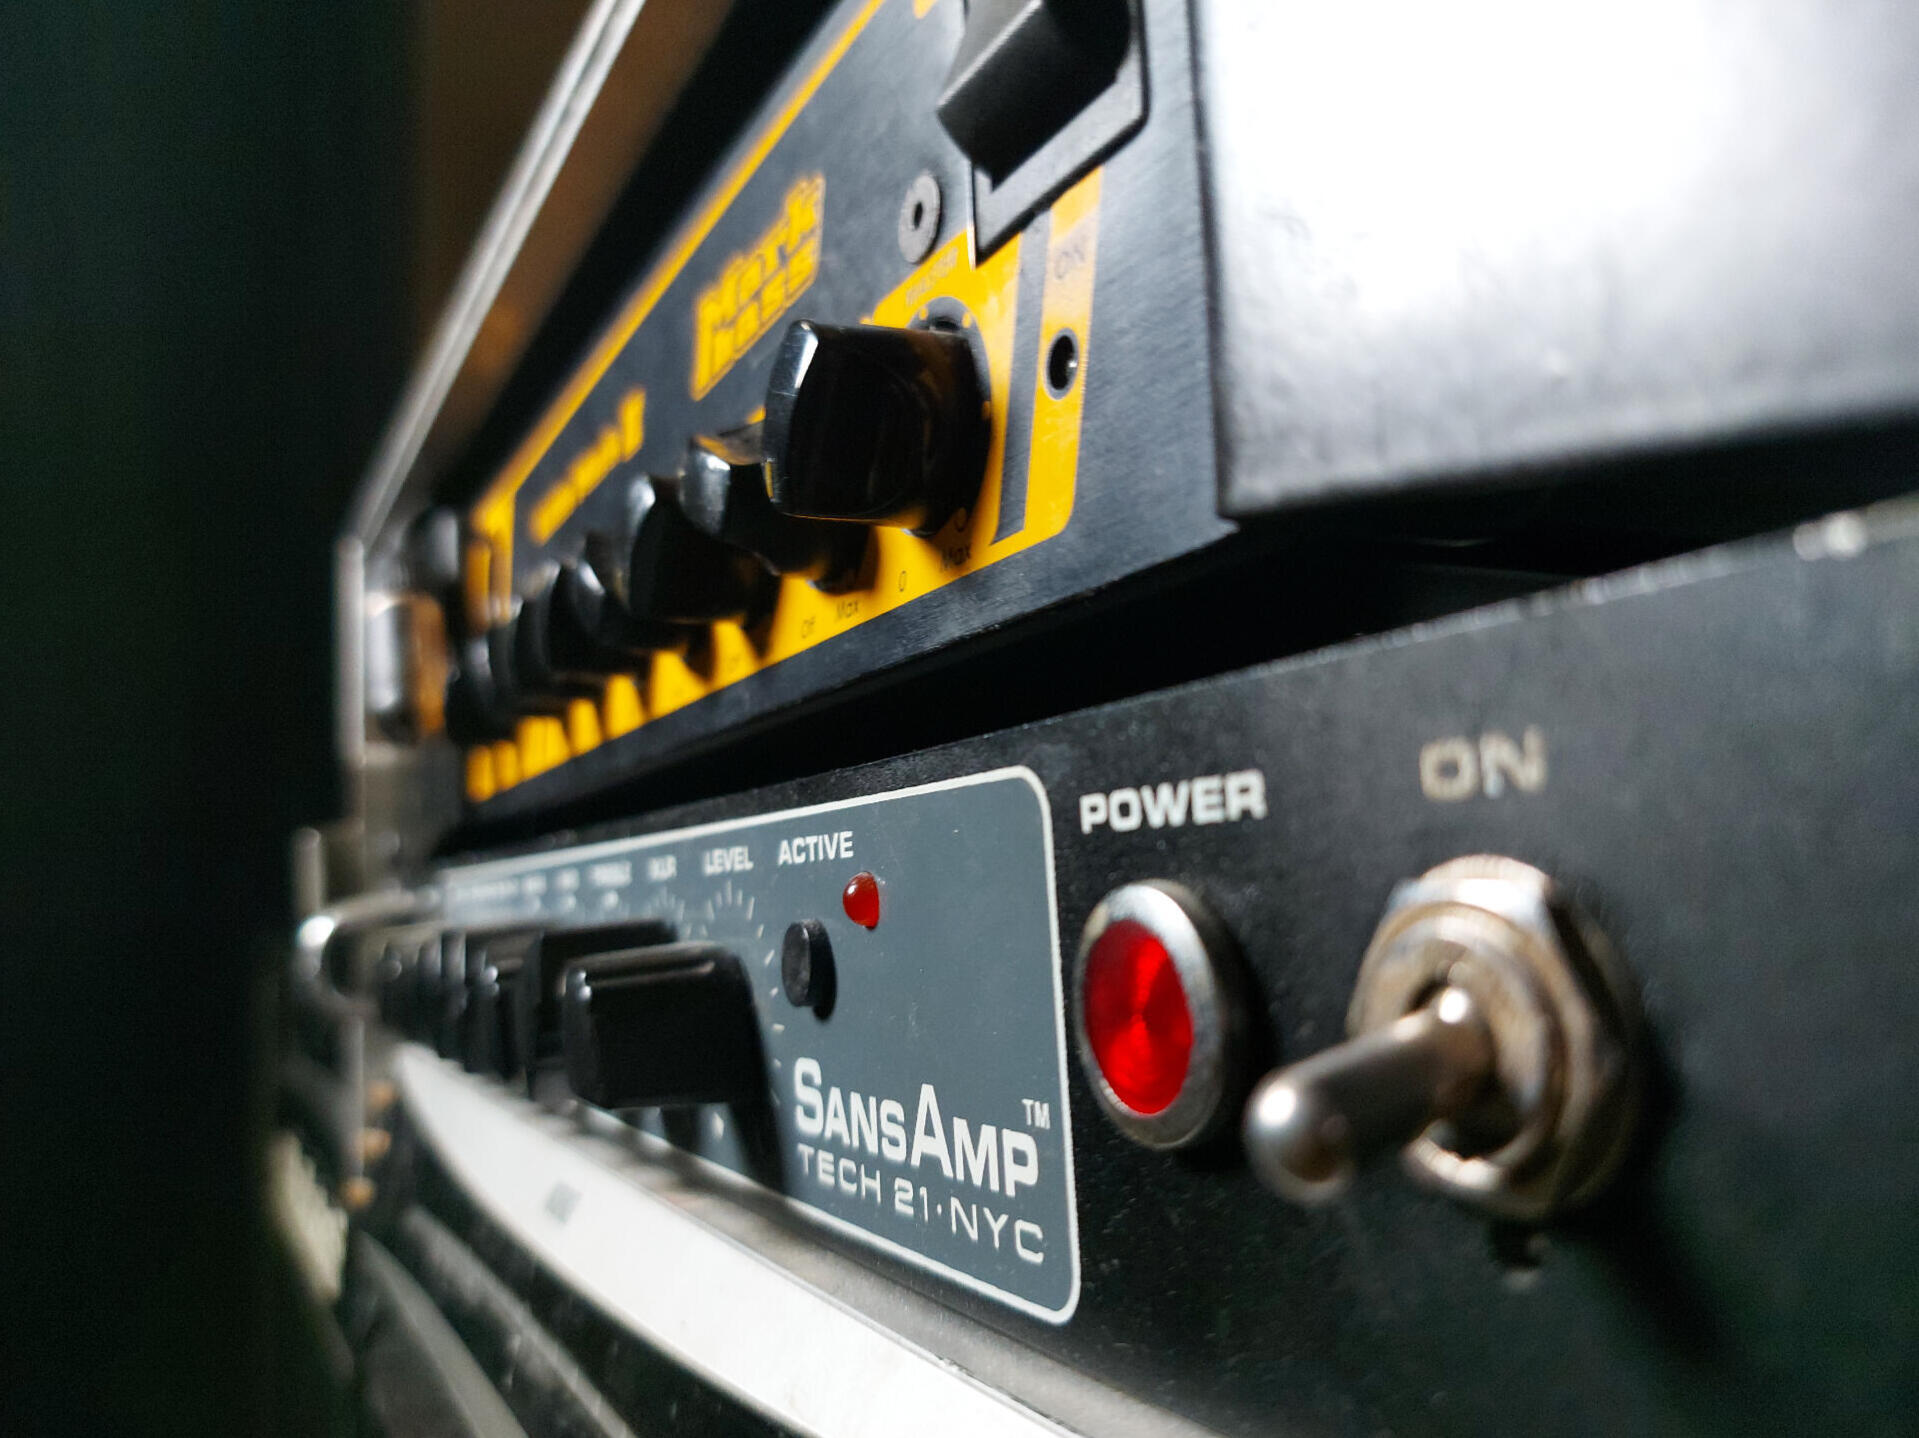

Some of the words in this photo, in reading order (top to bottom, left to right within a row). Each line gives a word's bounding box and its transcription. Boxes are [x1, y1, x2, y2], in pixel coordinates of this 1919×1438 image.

[1418, 724, 1548, 801] ON
[1079, 768, 1267, 834] POWER
[703, 845, 754, 876] LEVEL
[778, 830, 854, 866] ACTIVE
[797, 1142, 882, 1205] TECH
